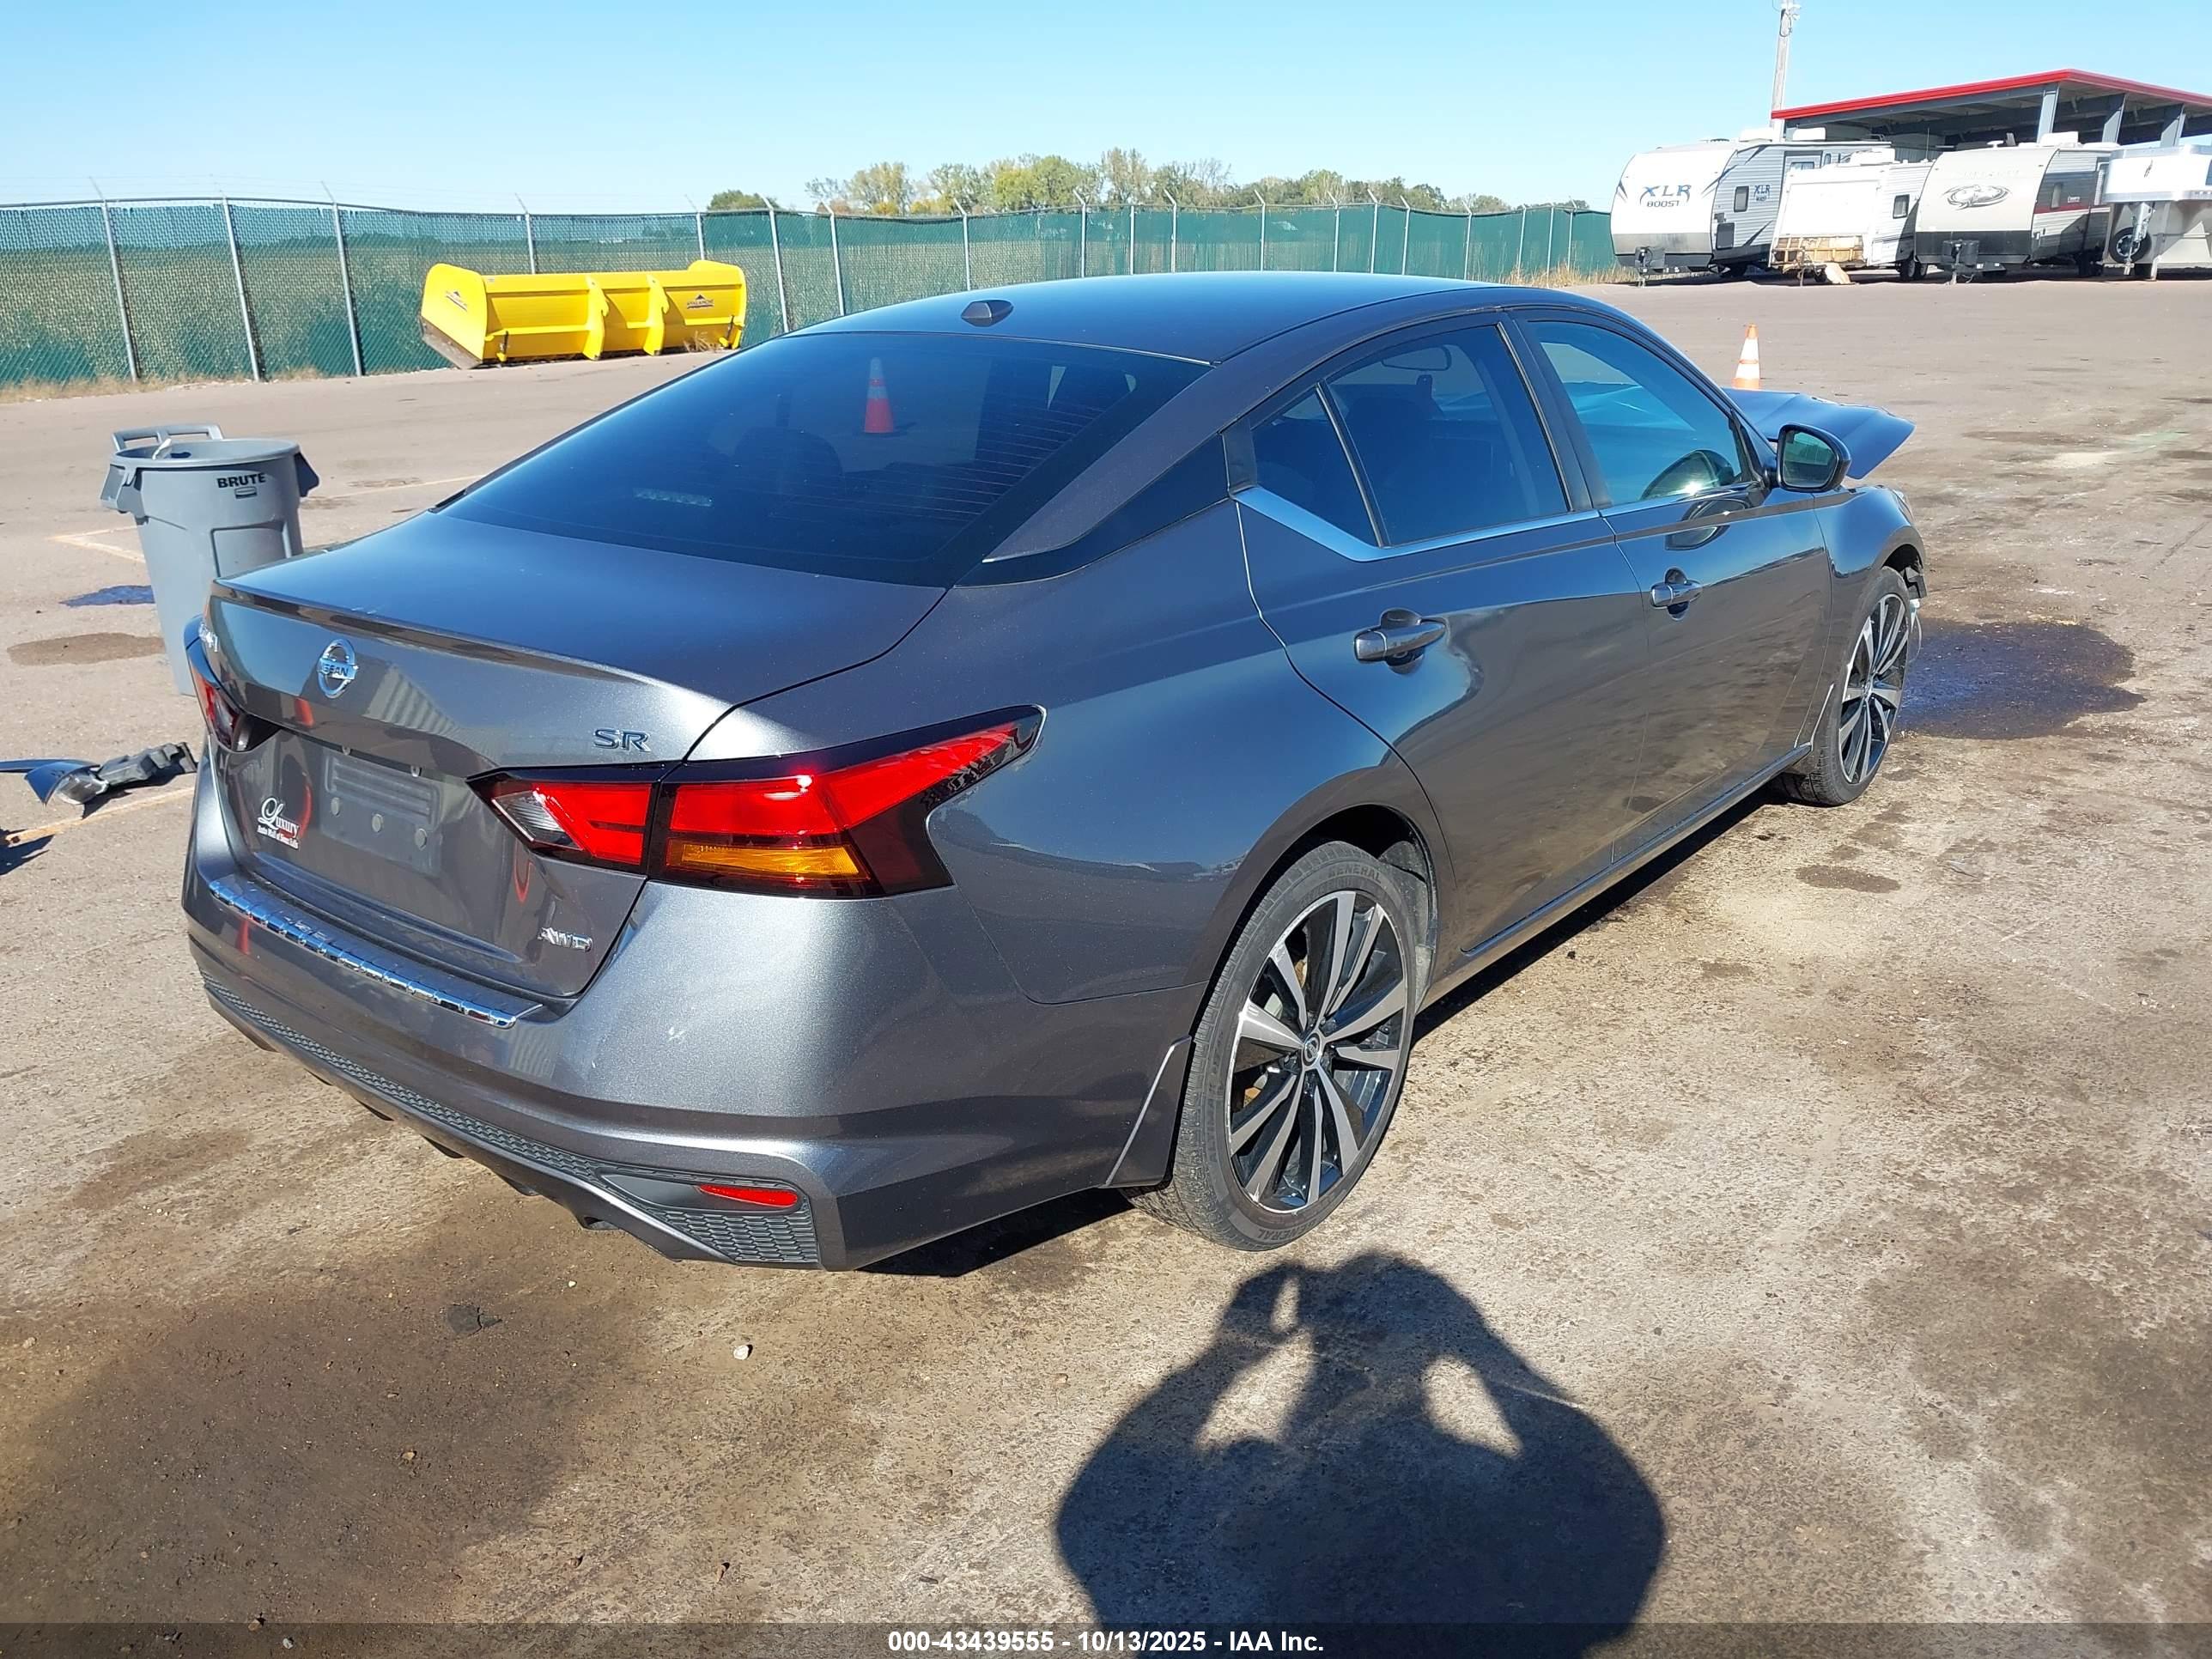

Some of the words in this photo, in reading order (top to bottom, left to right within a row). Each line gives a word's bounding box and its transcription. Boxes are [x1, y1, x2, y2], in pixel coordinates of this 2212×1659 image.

[1641, 184, 1692, 202] XLR
[217, 472, 266, 488] BRUTE
[592, 727, 652, 752] SR
[258, 798, 300, 838] Luxury
[537, 927, 593, 952] AWD
